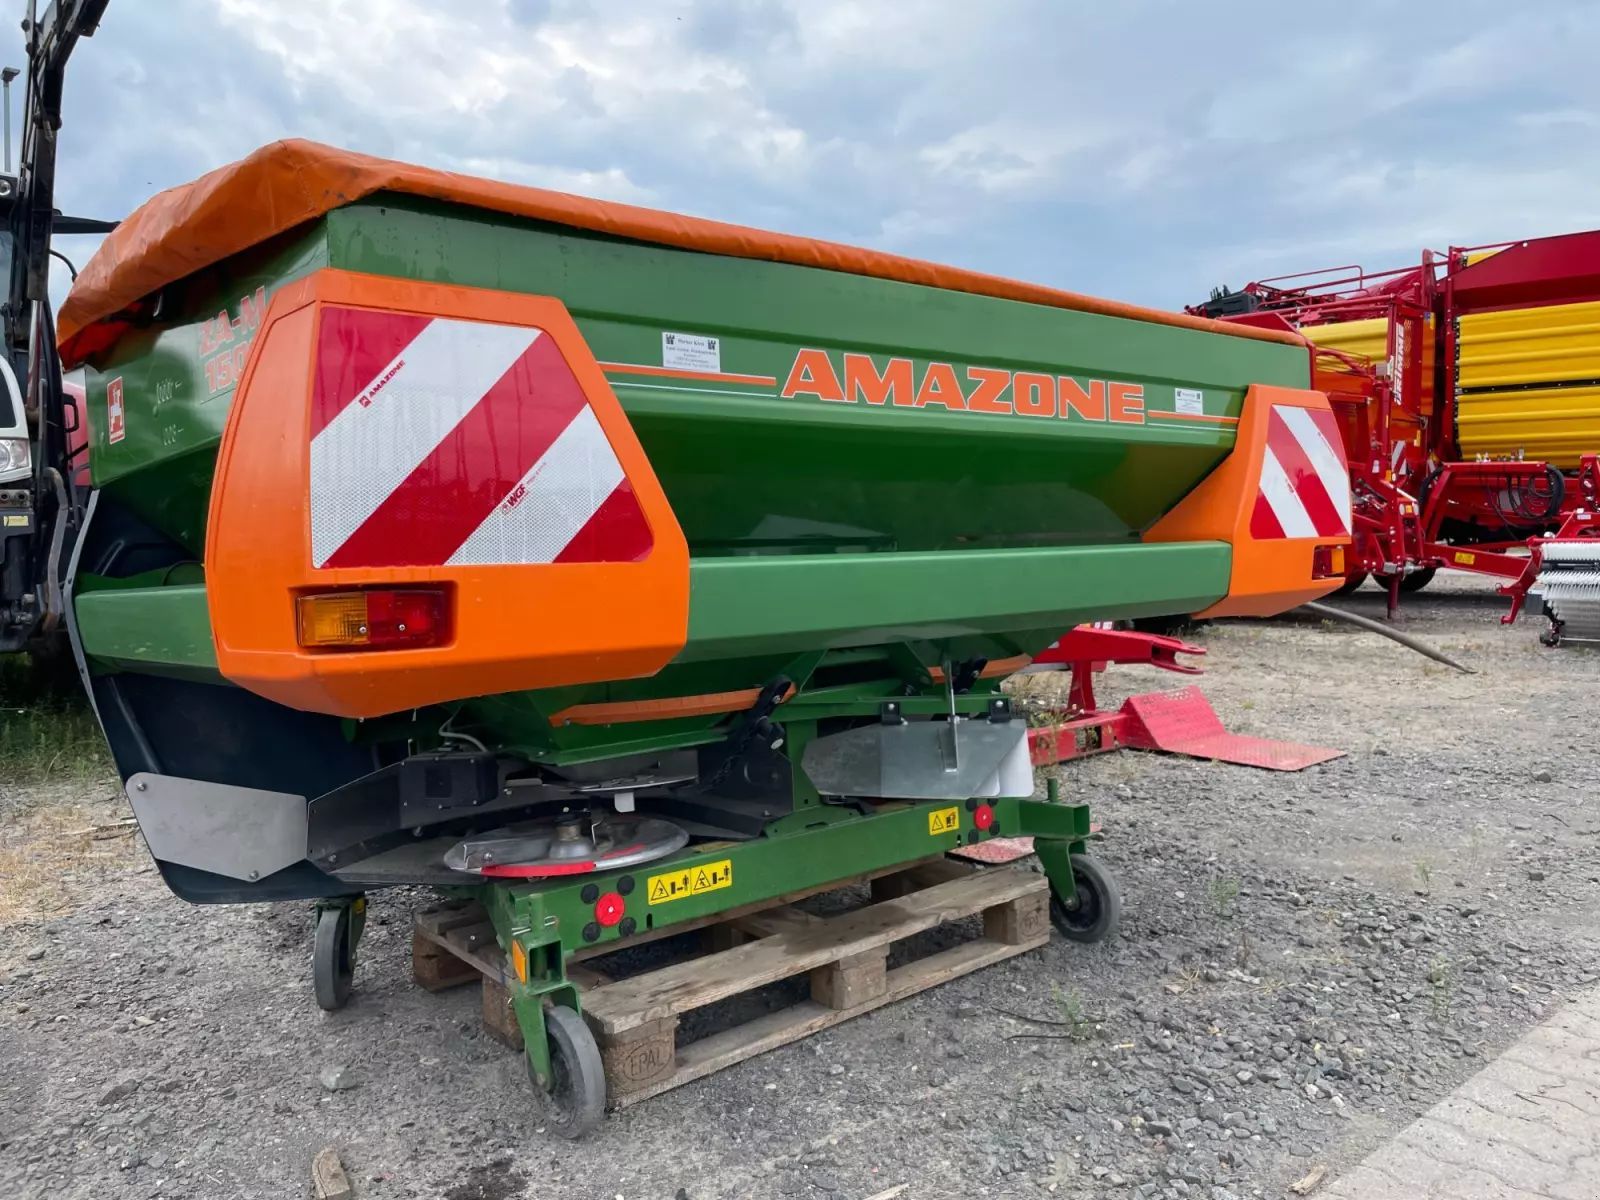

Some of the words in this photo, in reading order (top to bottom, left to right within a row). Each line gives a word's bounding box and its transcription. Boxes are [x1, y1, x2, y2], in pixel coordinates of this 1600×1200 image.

[199, 285, 265, 357] ZA-M
[369, 359, 406, 397] AMAZONE
[781, 347, 1145, 425] AMAZONE
[507, 483, 526, 507] WGF
[630, 1046, 666, 1077] EPAL
